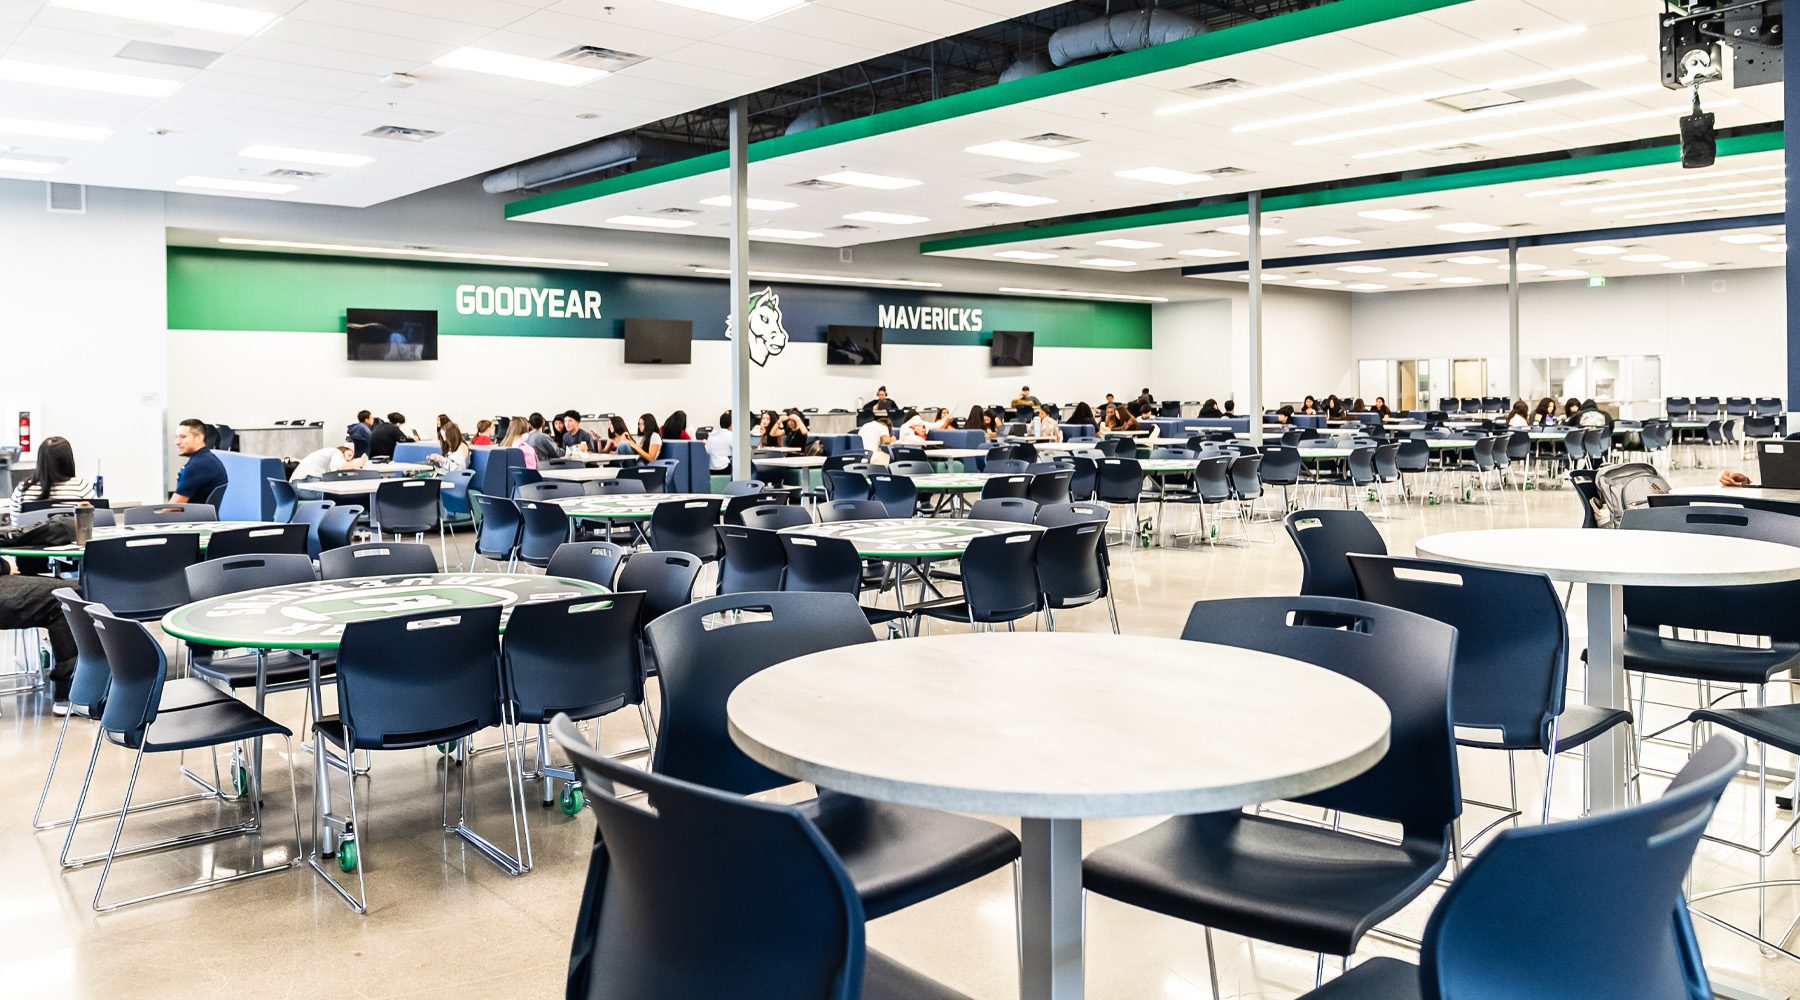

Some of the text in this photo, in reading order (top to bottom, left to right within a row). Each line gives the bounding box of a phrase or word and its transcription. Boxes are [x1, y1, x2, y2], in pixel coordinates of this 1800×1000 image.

[456, 284, 602, 320] GOODYEAR
[878, 304, 983, 332] MAVERICKS
[205, 576, 532, 617] MAVERICKS
